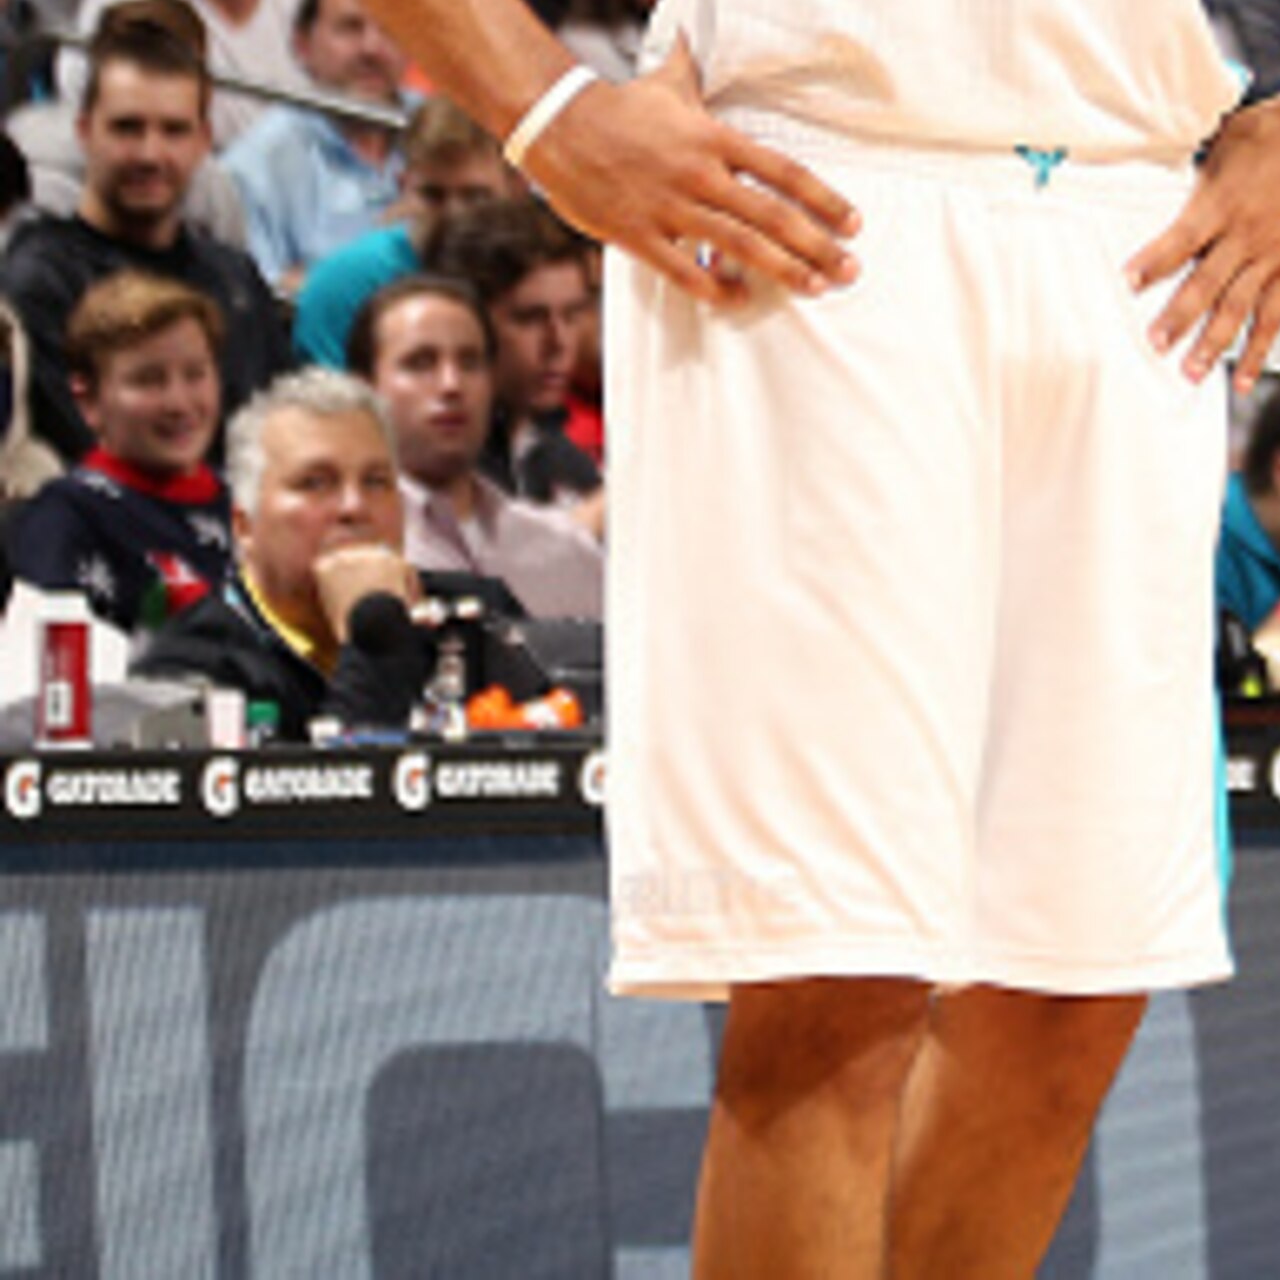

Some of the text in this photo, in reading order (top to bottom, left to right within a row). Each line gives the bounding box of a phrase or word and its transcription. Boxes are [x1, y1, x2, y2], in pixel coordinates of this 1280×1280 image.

[48, 772, 181, 804] GATORADE
[245, 767, 373, 800] GATORADE
[436, 763, 559, 797] GATORADE
